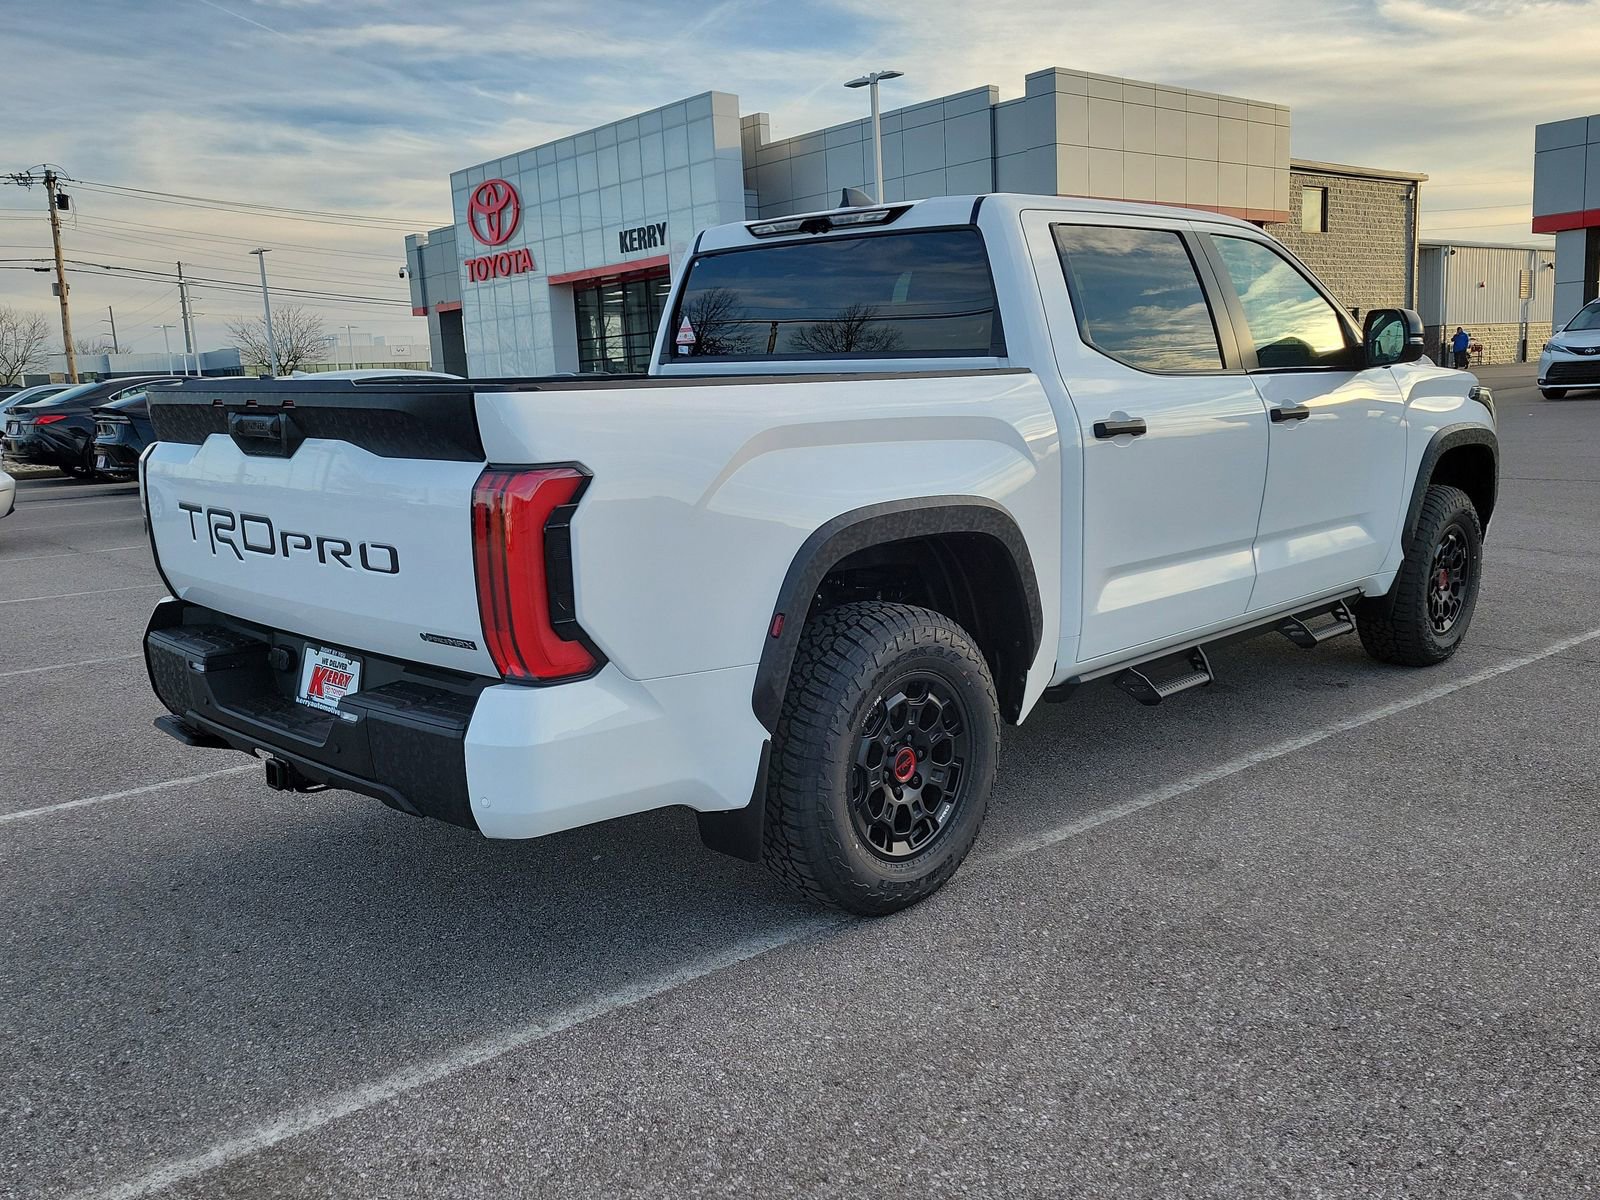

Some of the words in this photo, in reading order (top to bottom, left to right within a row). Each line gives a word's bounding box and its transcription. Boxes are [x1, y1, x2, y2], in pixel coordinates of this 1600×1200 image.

[618, 222, 667, 253] KERRY
[464, 248, 535, 282] TOYOTA
[280, 530, 400, 574] PRO
[321, 657, 329, 666] WE
[329, 659, 348, 671] DELIVER
[308, 665, 353, 698] KERRY
